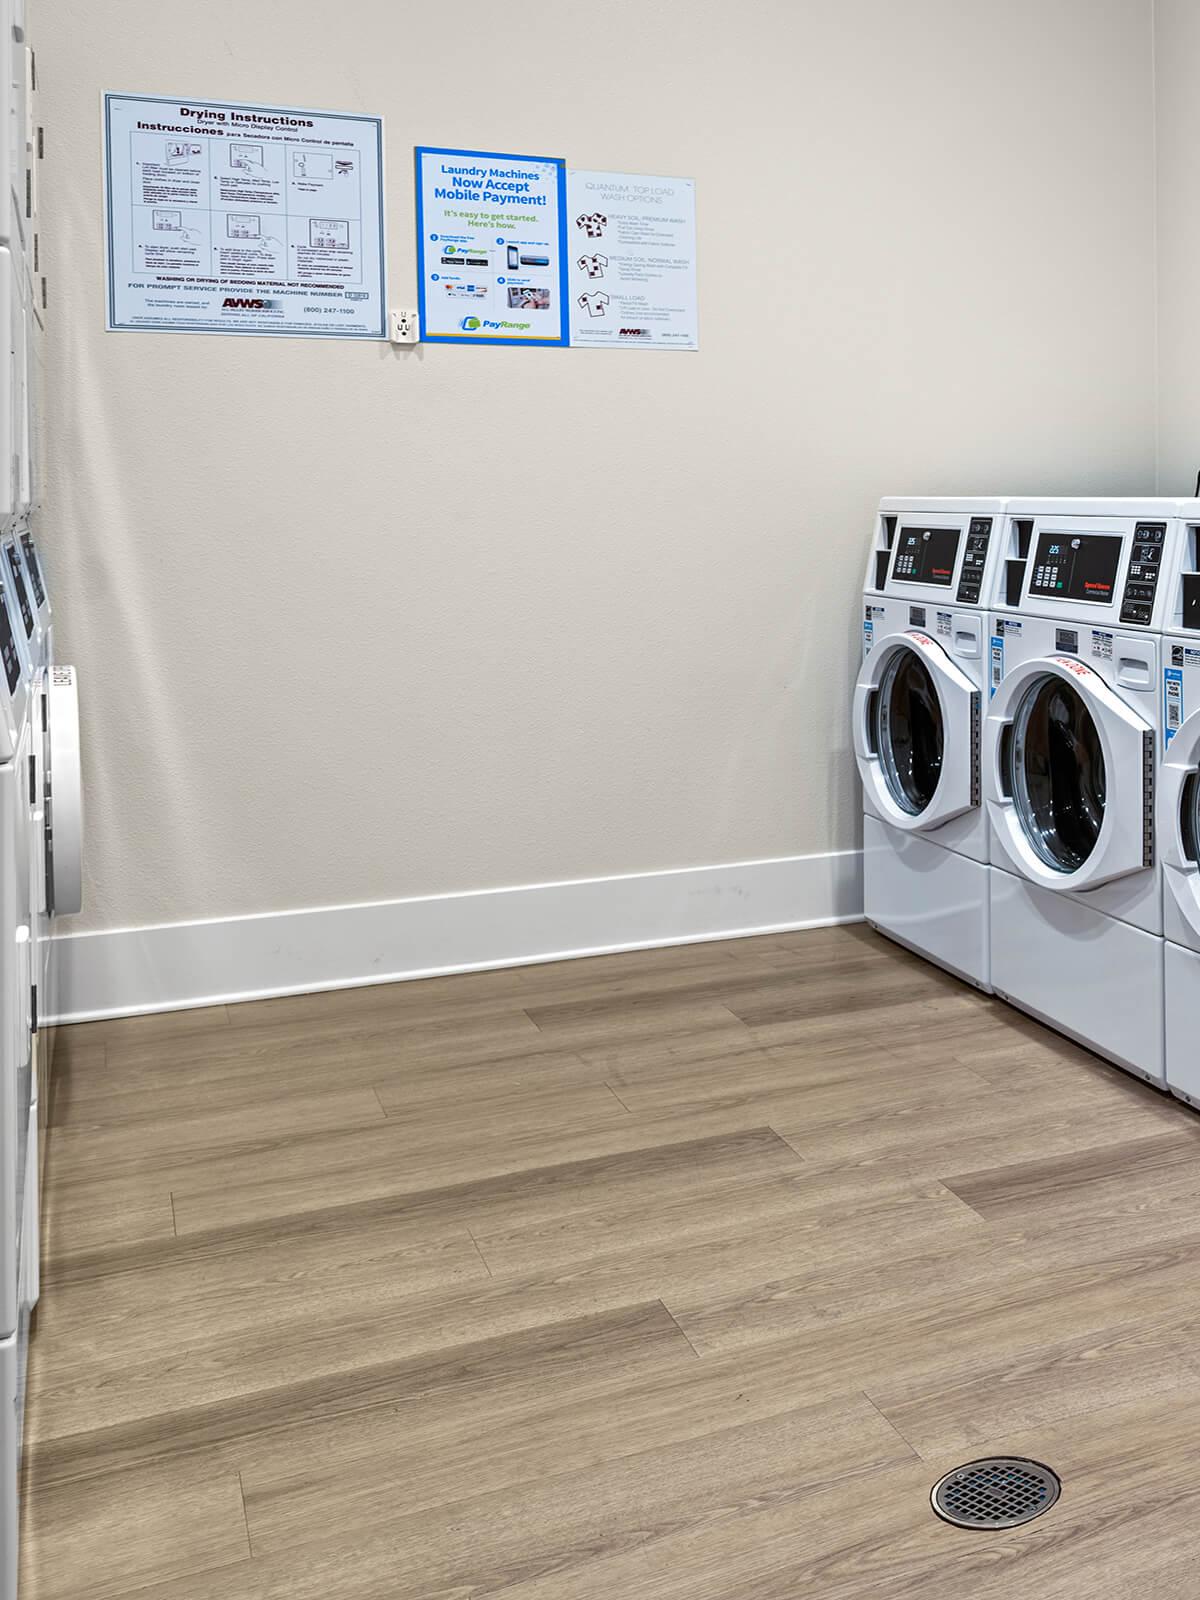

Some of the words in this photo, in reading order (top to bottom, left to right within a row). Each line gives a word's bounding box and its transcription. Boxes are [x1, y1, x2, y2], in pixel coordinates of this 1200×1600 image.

[180, 107, 225, 121] Drying
[231, 112, 314, 128] Instructions
[137, 121, 224, 136] Instrucciones
[251, 123, 274, 131] Display
[441, 165, 487, 178] Laundry
[489, 168, 540, 180] Machines
[452, 177, 483, 188] Now
[485, 179, 530, 193] Accept
[434, 188, 480, 201] Mobile
[483, 191, 546, 205] Payment!
[627, 194, 664, 204] OPTIONS
[459, 211, 478, 219] easy
[480, 211, 489, 219] to
[491, 213, 504, 221] get
[506, 213, 538, 222] started.
[468, 220, 494, 228] Here's
[496, 221, 516, 229] how.
[273, 289, 308, 297] MACHINE
[323, 307, 355, 315] 247-1100
[483, 320, 530, 329] PayRange
